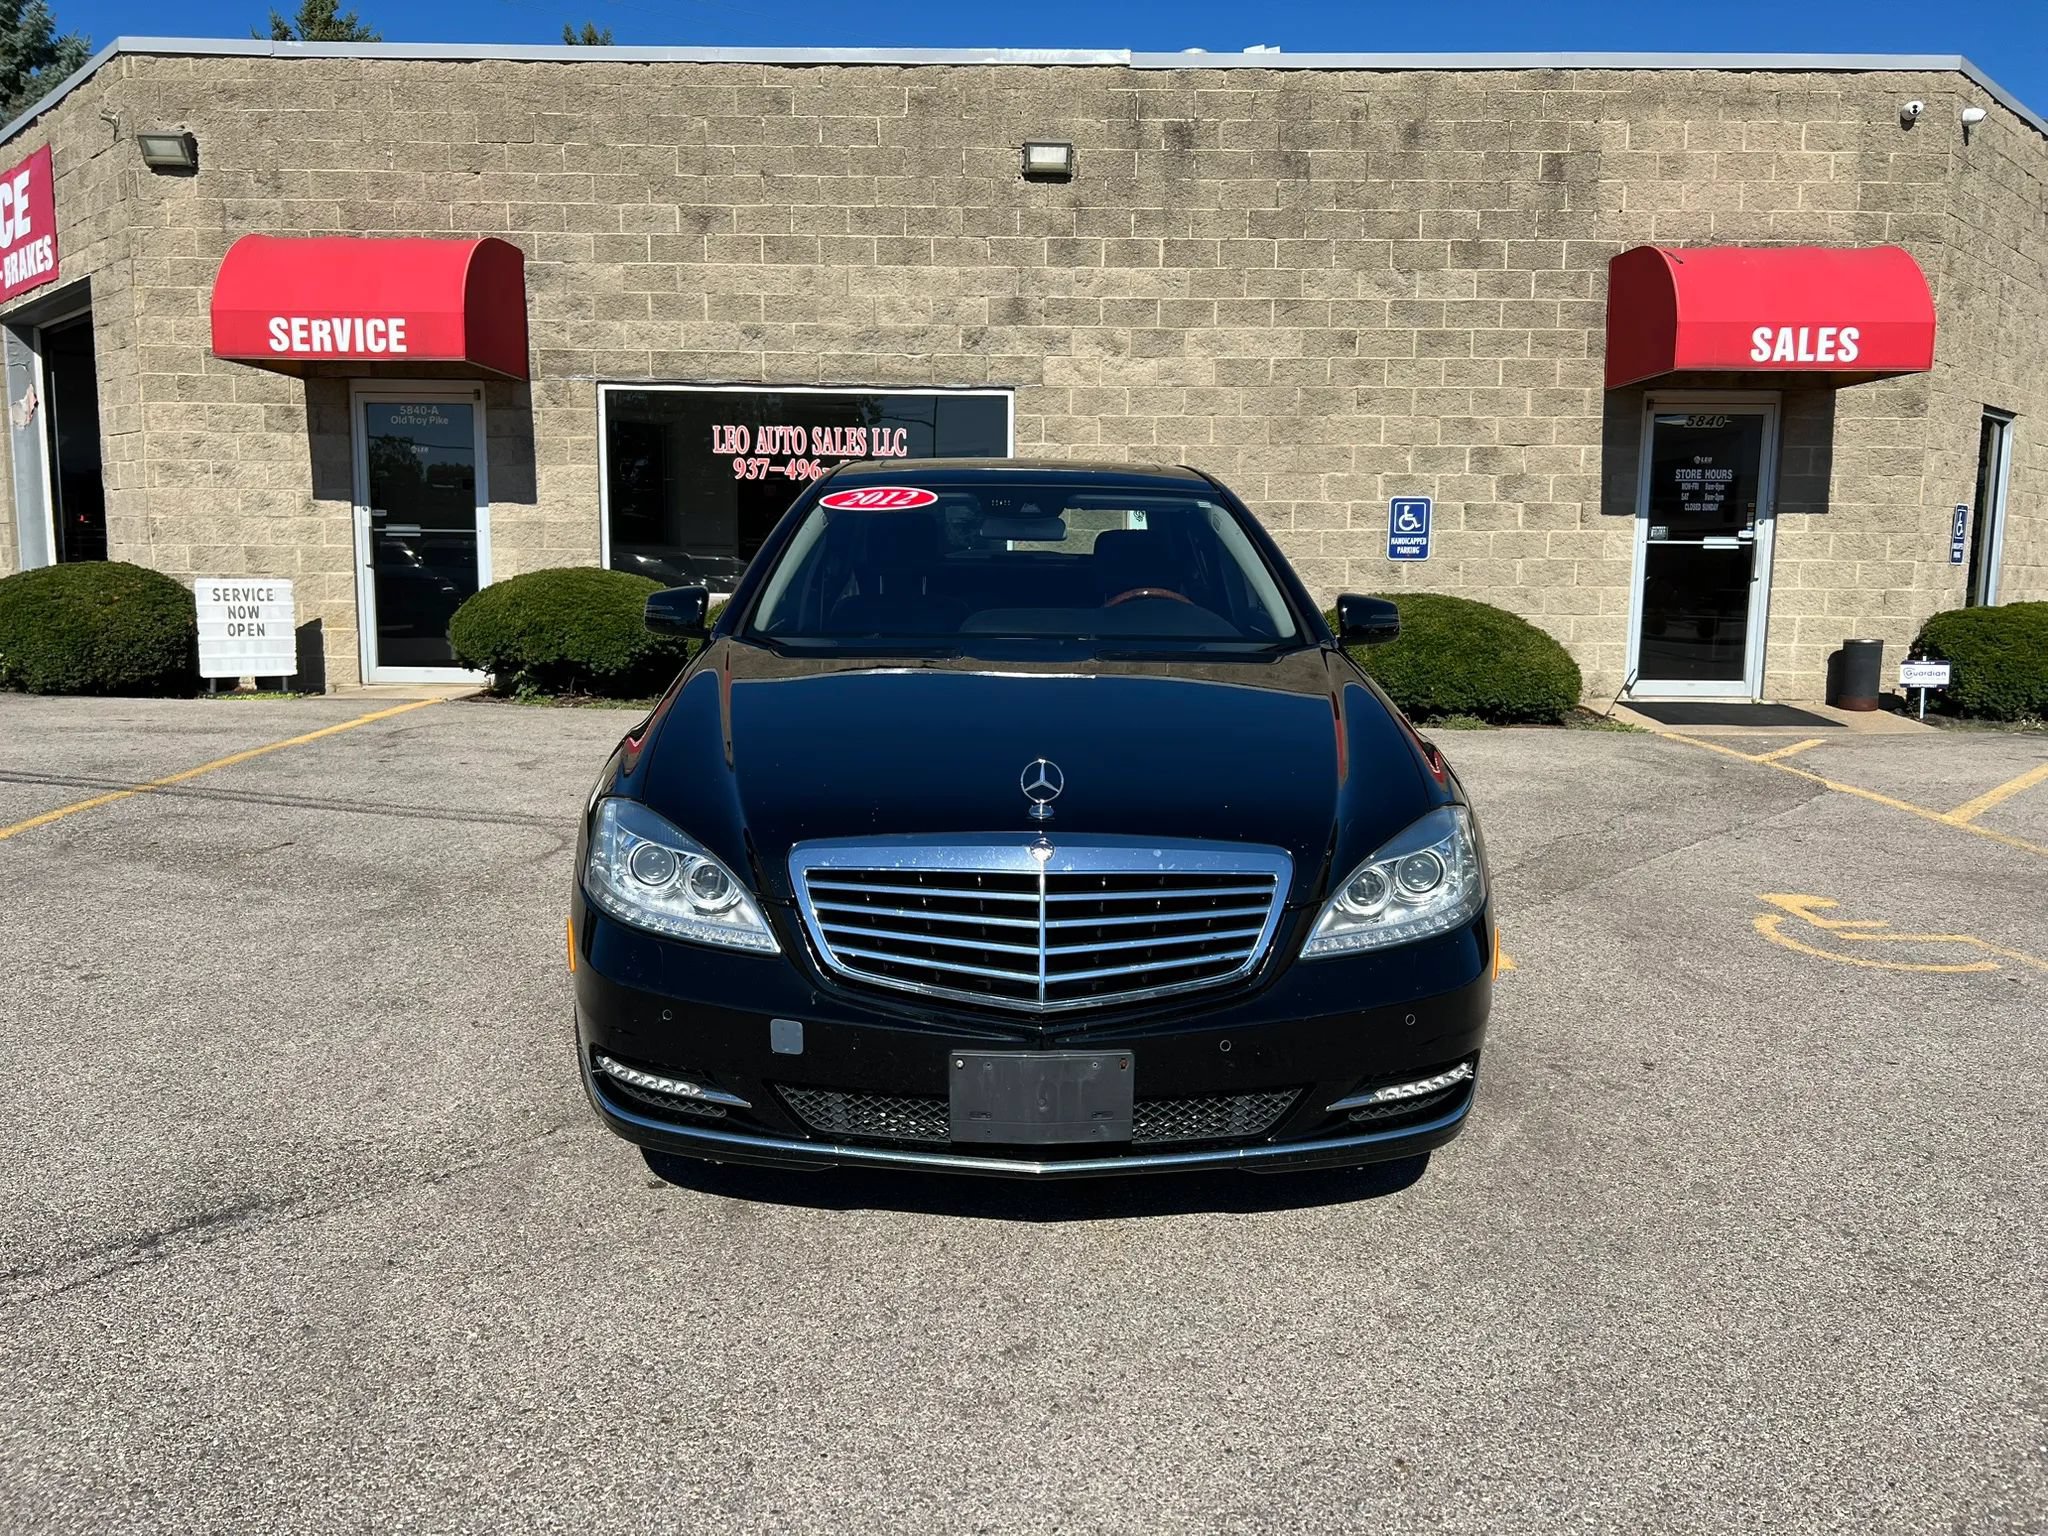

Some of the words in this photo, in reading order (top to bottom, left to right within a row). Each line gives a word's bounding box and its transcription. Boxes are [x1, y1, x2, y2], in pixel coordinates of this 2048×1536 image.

[4, 235, 53, 289] BRAKES
[268, 316, 407, 353] SERVICE
[1750, 326, 1860, 362] SALES
[399, 405, 439, 415] 5840-A
[390, 415, 407, 425] Old
[408, 415, 427, 426] Troy
[429, 415, 449, 425] Pike
[1685, 415, 1726, 427] 5840
[713, 425, 750, 454] LEO
[755, 426, 807, 455] AUTO
[812, 427, 866, 456] SALES
[872, 428, 907, 457] LLC
[733, 457, 849, 480] 937-496-
[1675, 469, 1702, 479] STORE
[1704, 469, 1733, 479] HOURS
[837, 491, 920, 506] 2012
[1391, 537, 1427, 545] HANDICAPPED
[212, 588, 275, 602] SERVICE
[227, 605, 260, 619] NOW
[227, 623, 266, 637] OPEN
[1904, 669, 1947, 677] Guardian
